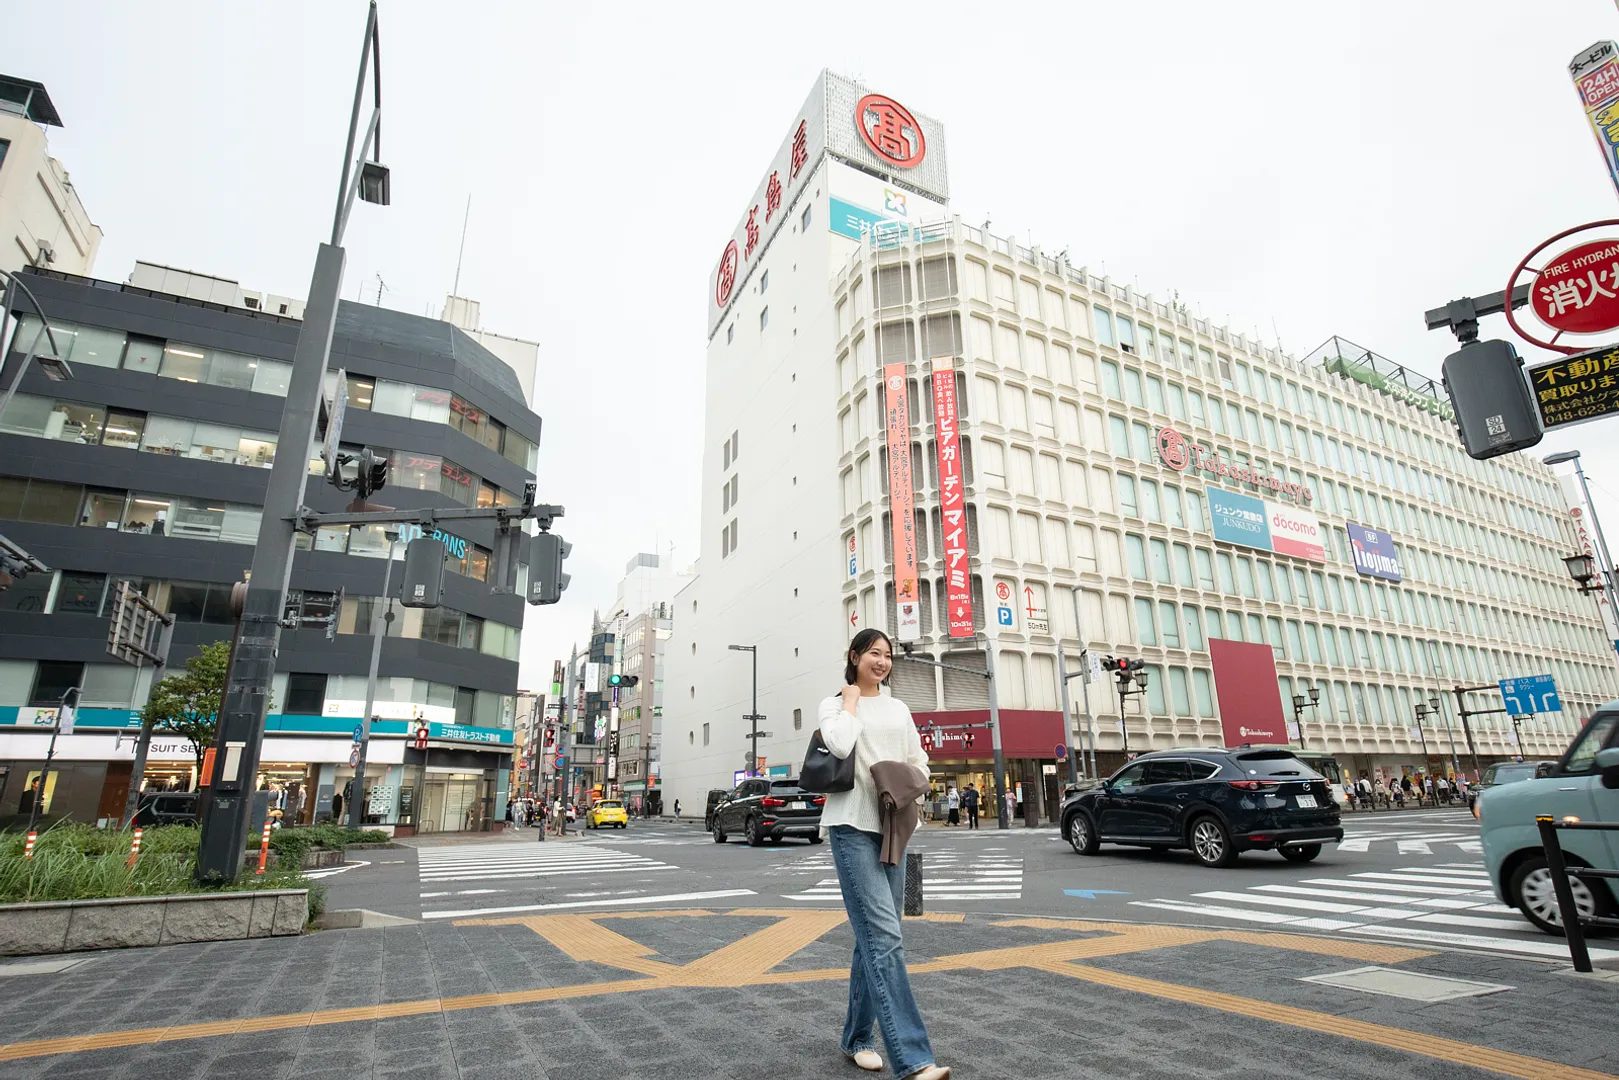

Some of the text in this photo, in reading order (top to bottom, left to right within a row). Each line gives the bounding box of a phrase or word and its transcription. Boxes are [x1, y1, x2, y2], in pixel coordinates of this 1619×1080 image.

[1583, 66, 1617, 94] 24H
[1543, 262, 1570, 279] FIRE
[1538, 373, 1619, 404] 買取りま
[1223, 517, 1261, 534] JUNKUDO
[1273, 512, 1317, 536] docomo
[150, 744, 178, 753] SUIT
